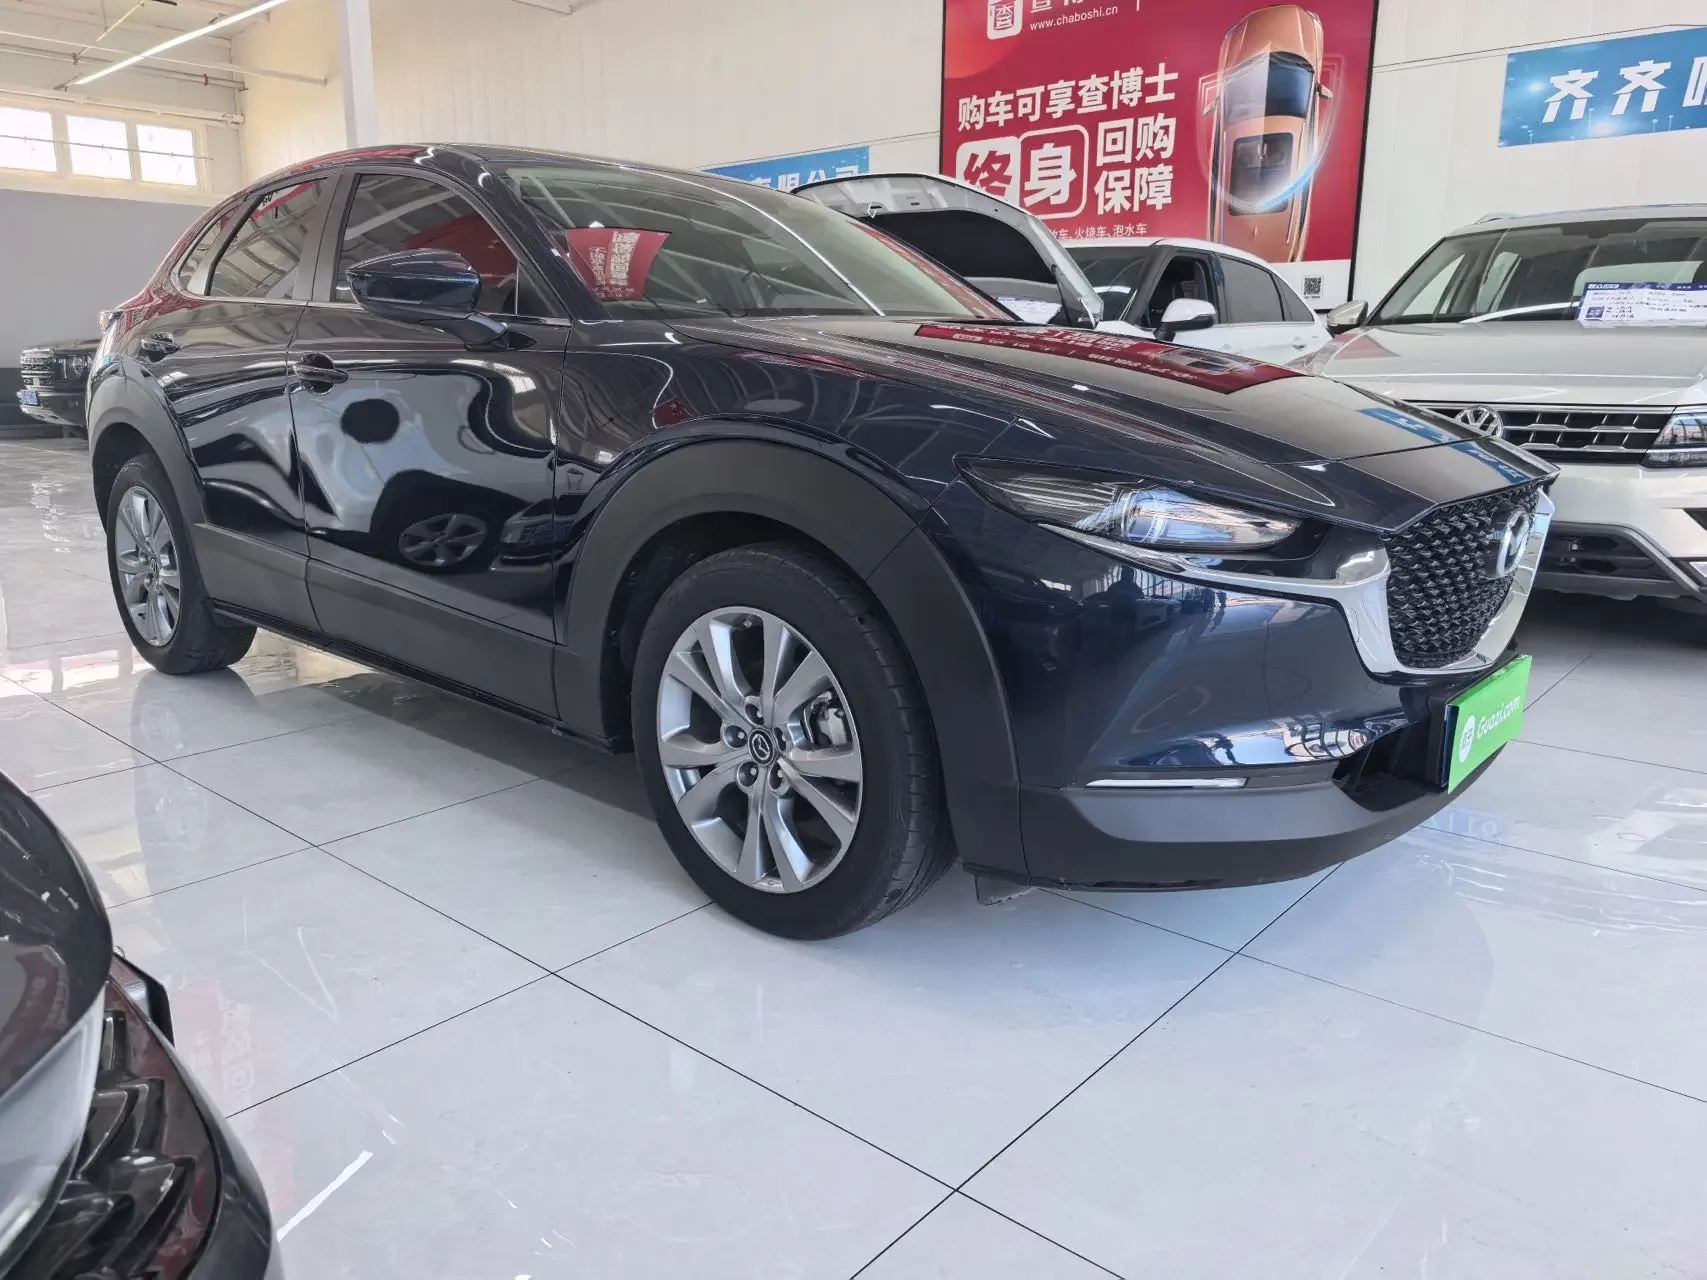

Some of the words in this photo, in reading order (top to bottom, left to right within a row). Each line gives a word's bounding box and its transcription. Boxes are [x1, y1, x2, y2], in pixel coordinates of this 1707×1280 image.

[1030, 5, 1118, 31] www.chaboshi.cn
[957, 62, 1179, 132] 购车可享查博士
[1096, 113, 1177, 165] 回购
[964, 142, 1077, 206] 终身
[1094, 163, 1175, 216] 保障
[1477, 695, 1520, 739] Guazi.com
